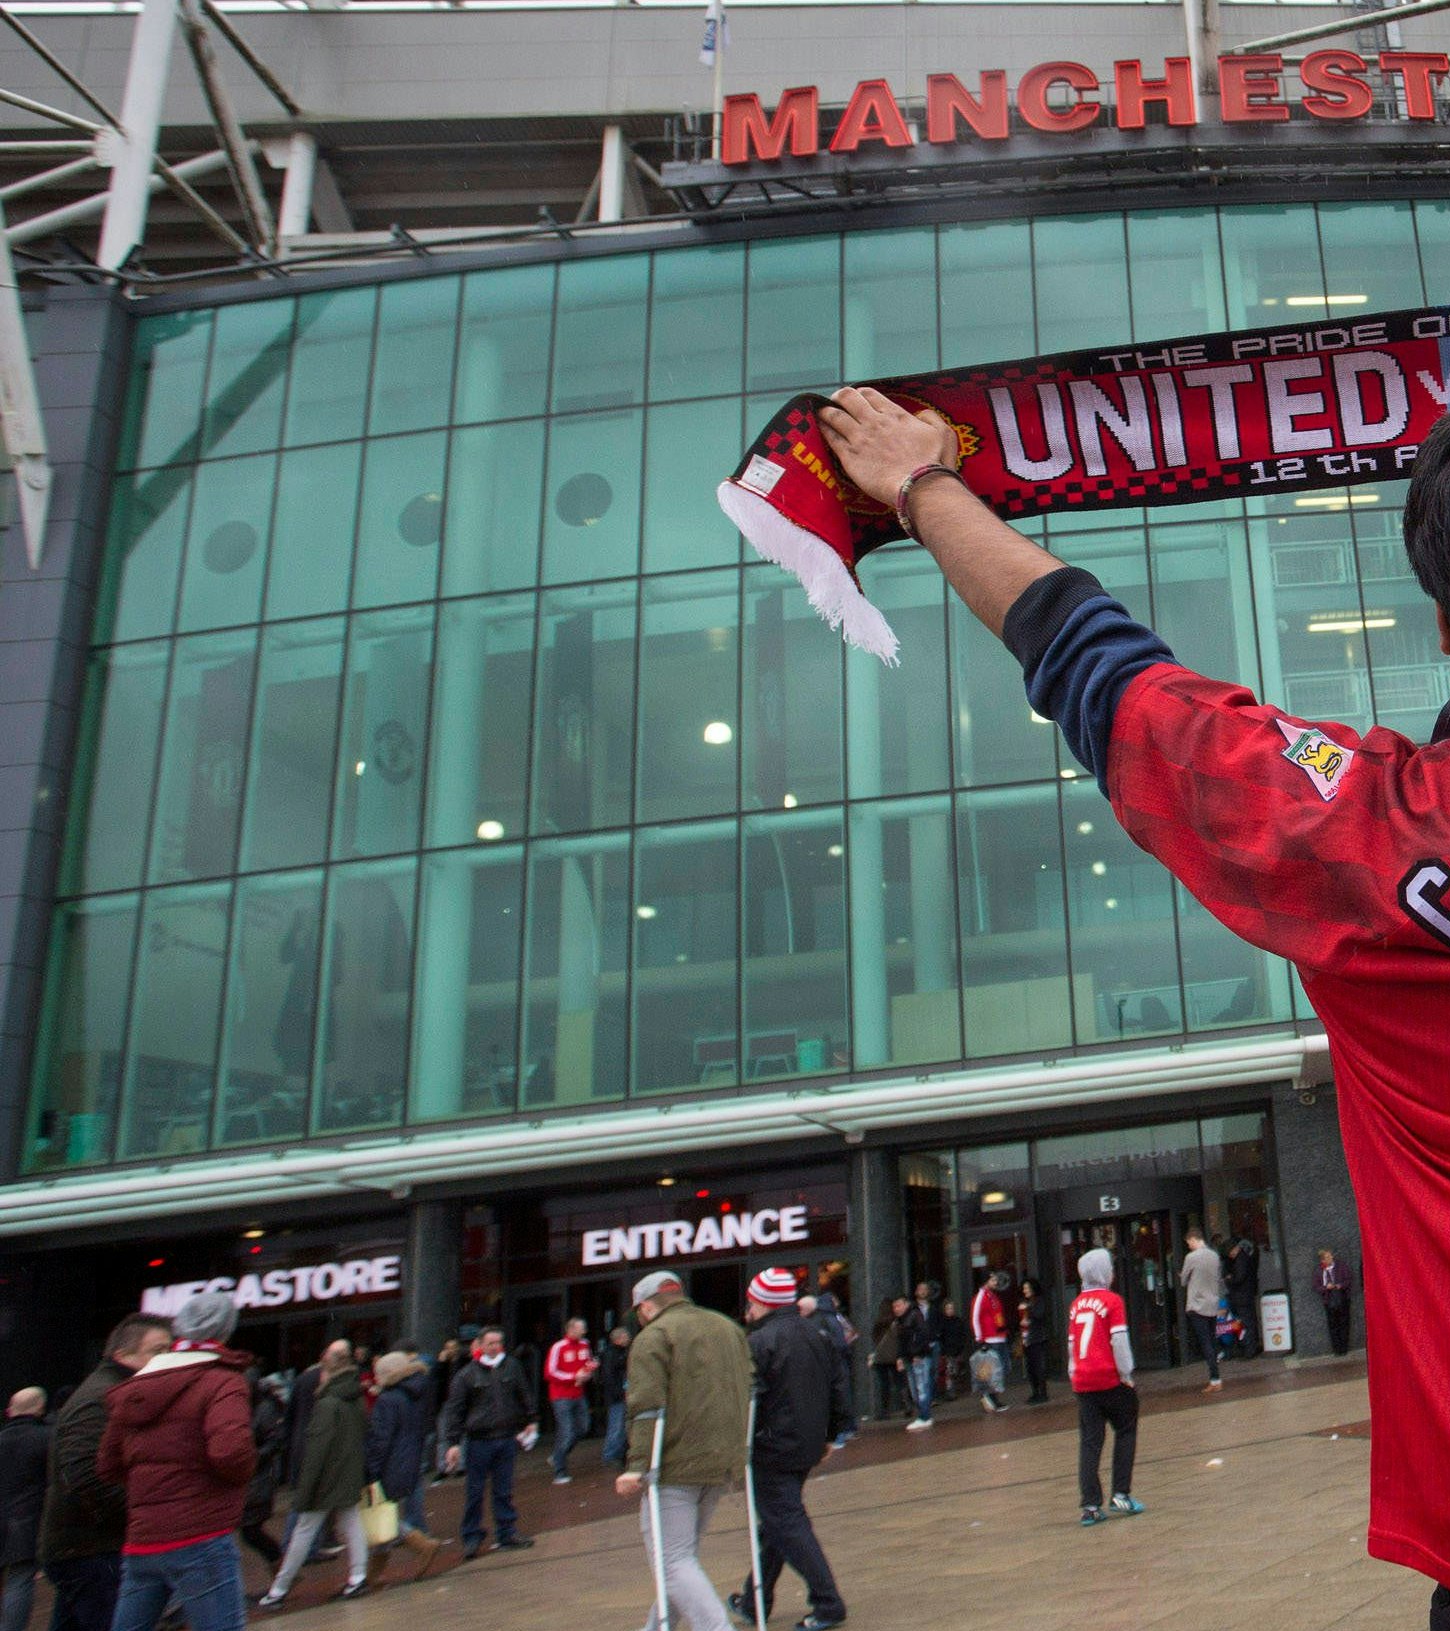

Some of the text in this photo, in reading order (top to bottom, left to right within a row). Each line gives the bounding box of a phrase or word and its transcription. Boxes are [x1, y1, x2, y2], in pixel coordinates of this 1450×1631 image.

[1099, 345, 1209, 372] THE
[1232, 322, 1387, 359] PRIDE
[985, 349, 1409, 482] UNITED
[1099, 1195, 1121, 1212] E3
[582, 1205, 809, 1267] ENTRANCE
[1075, 1311, 1095, 1359] 7
